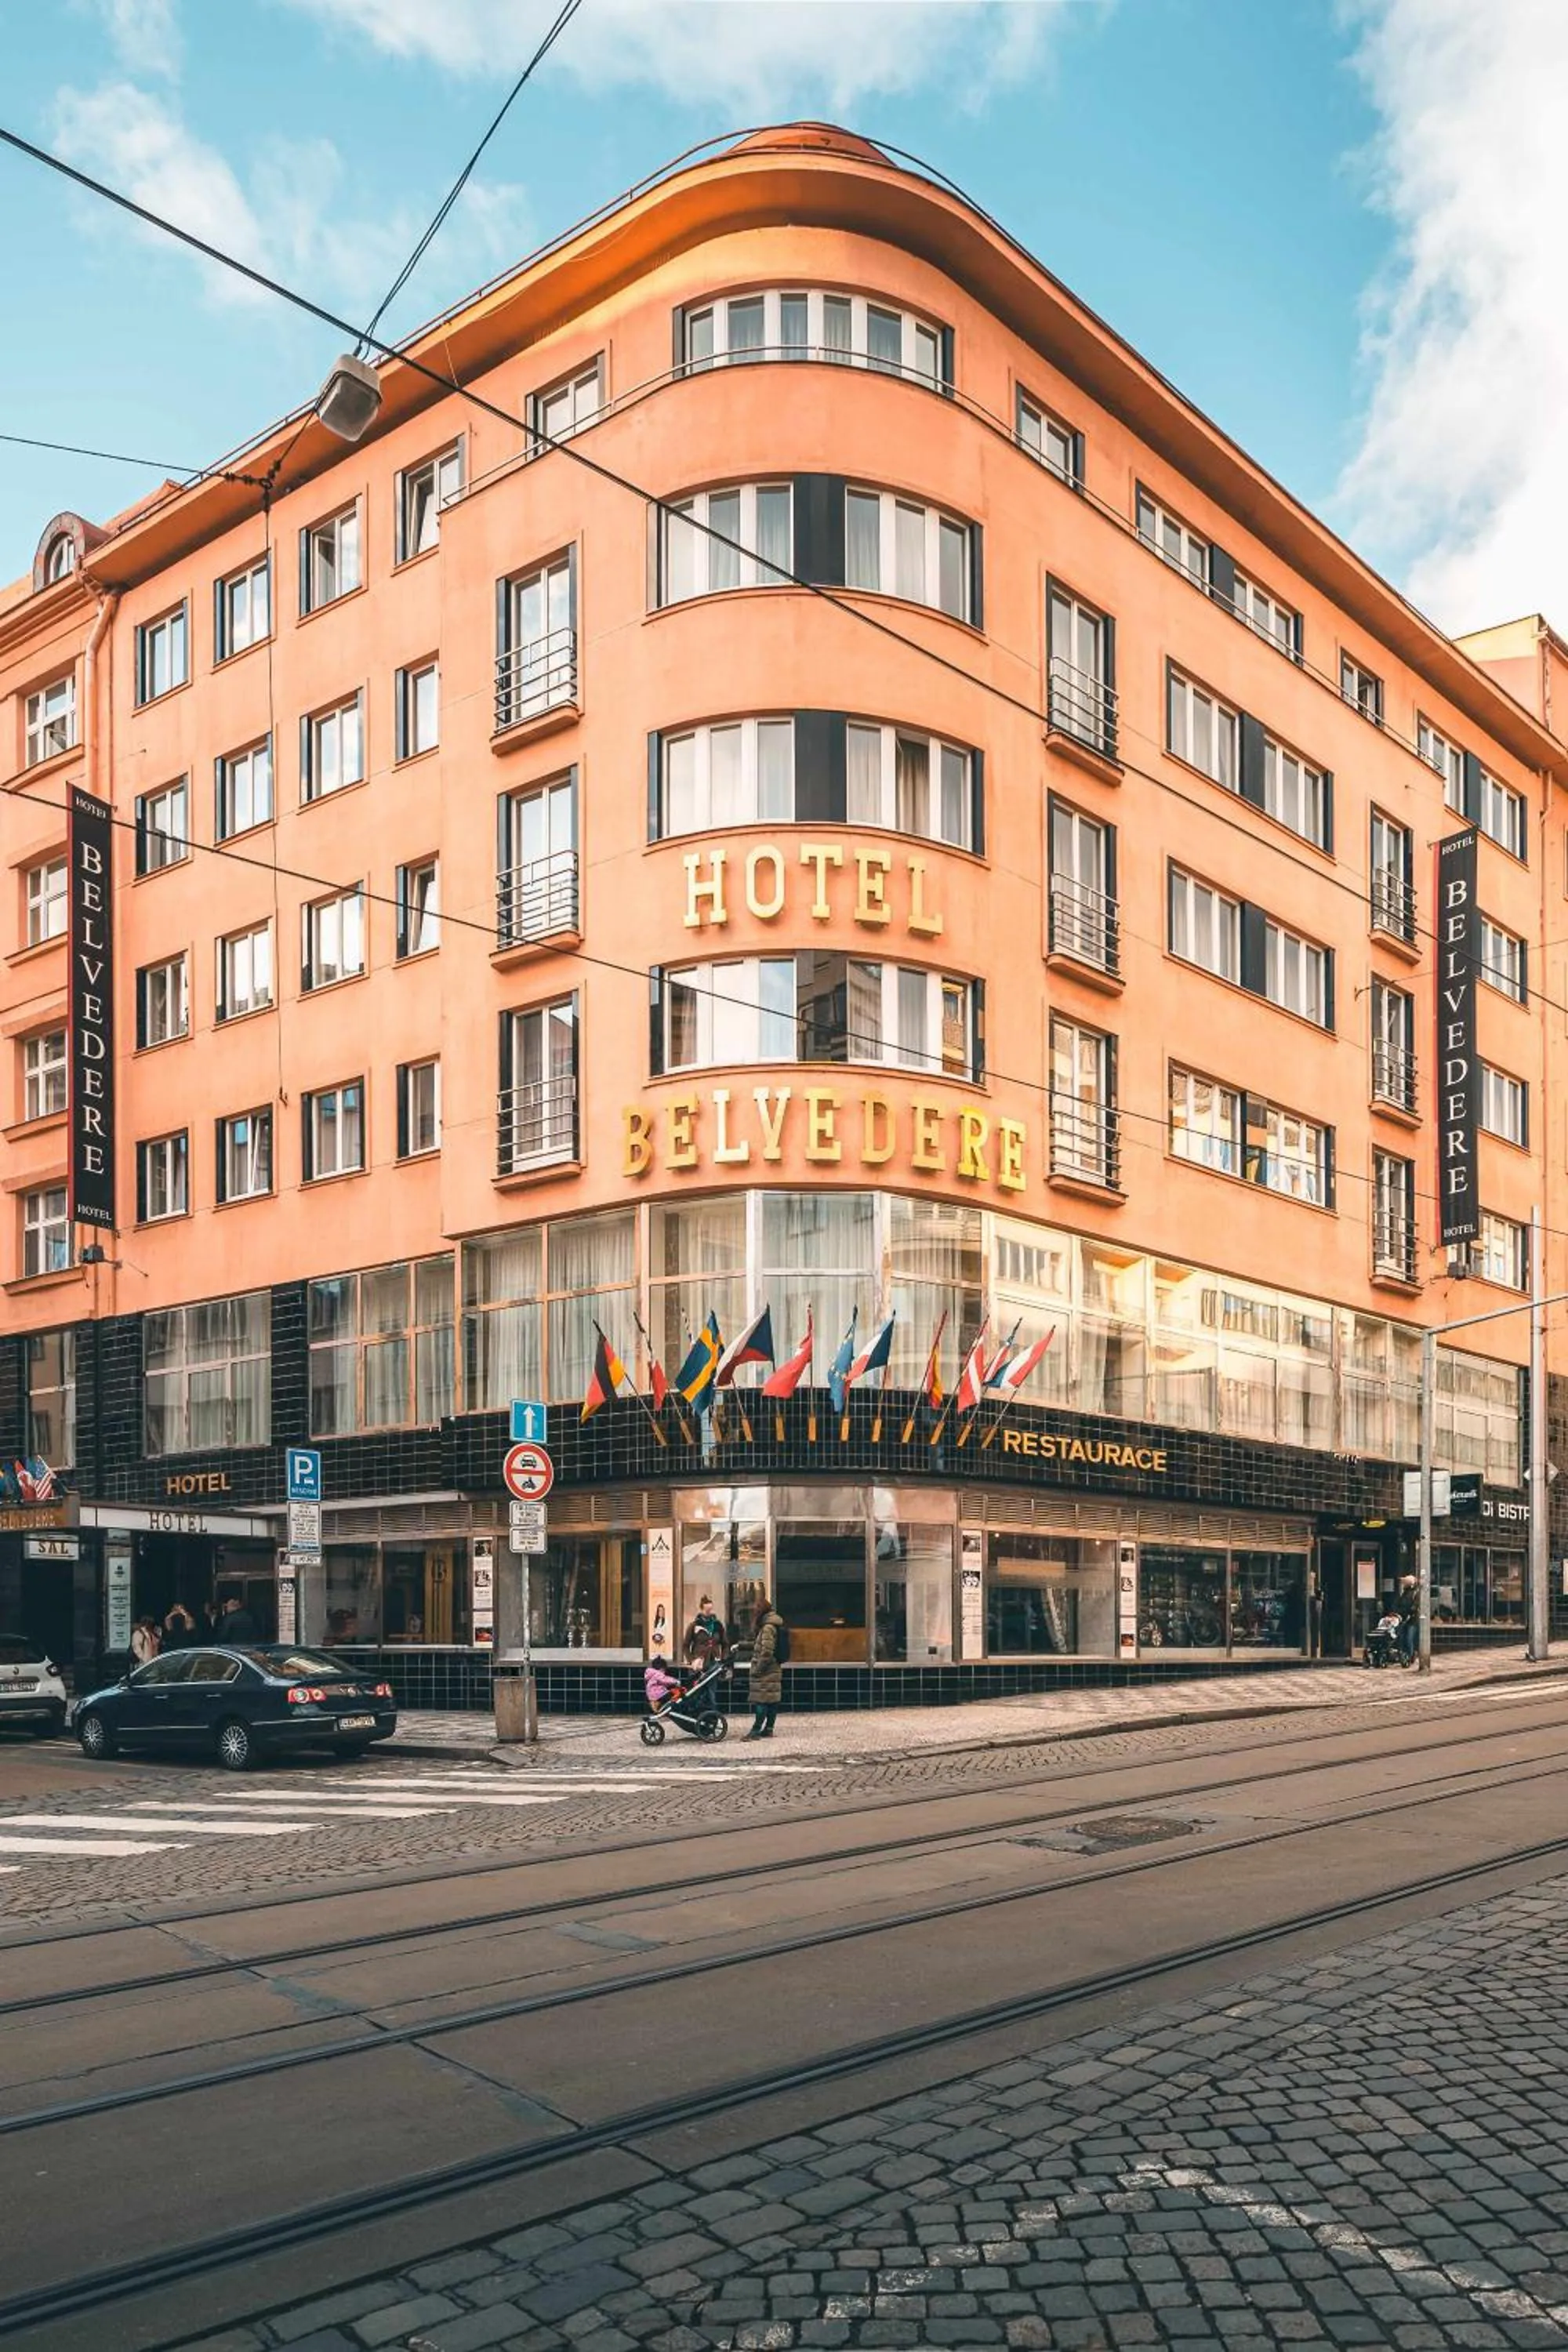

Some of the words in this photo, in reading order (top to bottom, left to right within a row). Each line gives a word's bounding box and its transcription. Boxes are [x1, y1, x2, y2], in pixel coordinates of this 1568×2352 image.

[1442, 835, 1475, 855] HOTEL
[683, 844, 942, 935] HOTEL
[80, 841, 107, 1175] BELVEDERE
[1443, 880, 1469, 1194] BELVEDERE
[622, 1087, 1027, 1192] BELVEDERE
[78, 1203, 112, 1221] HOTEL
[1443, 1224, 1476, 1238] HOTEL
[1004, 1429, 1167, 1472] RESTAURACE
[166, 1473, 232, 1495] HOTEL
[150, 1511, 207, 1533] HOTEL
